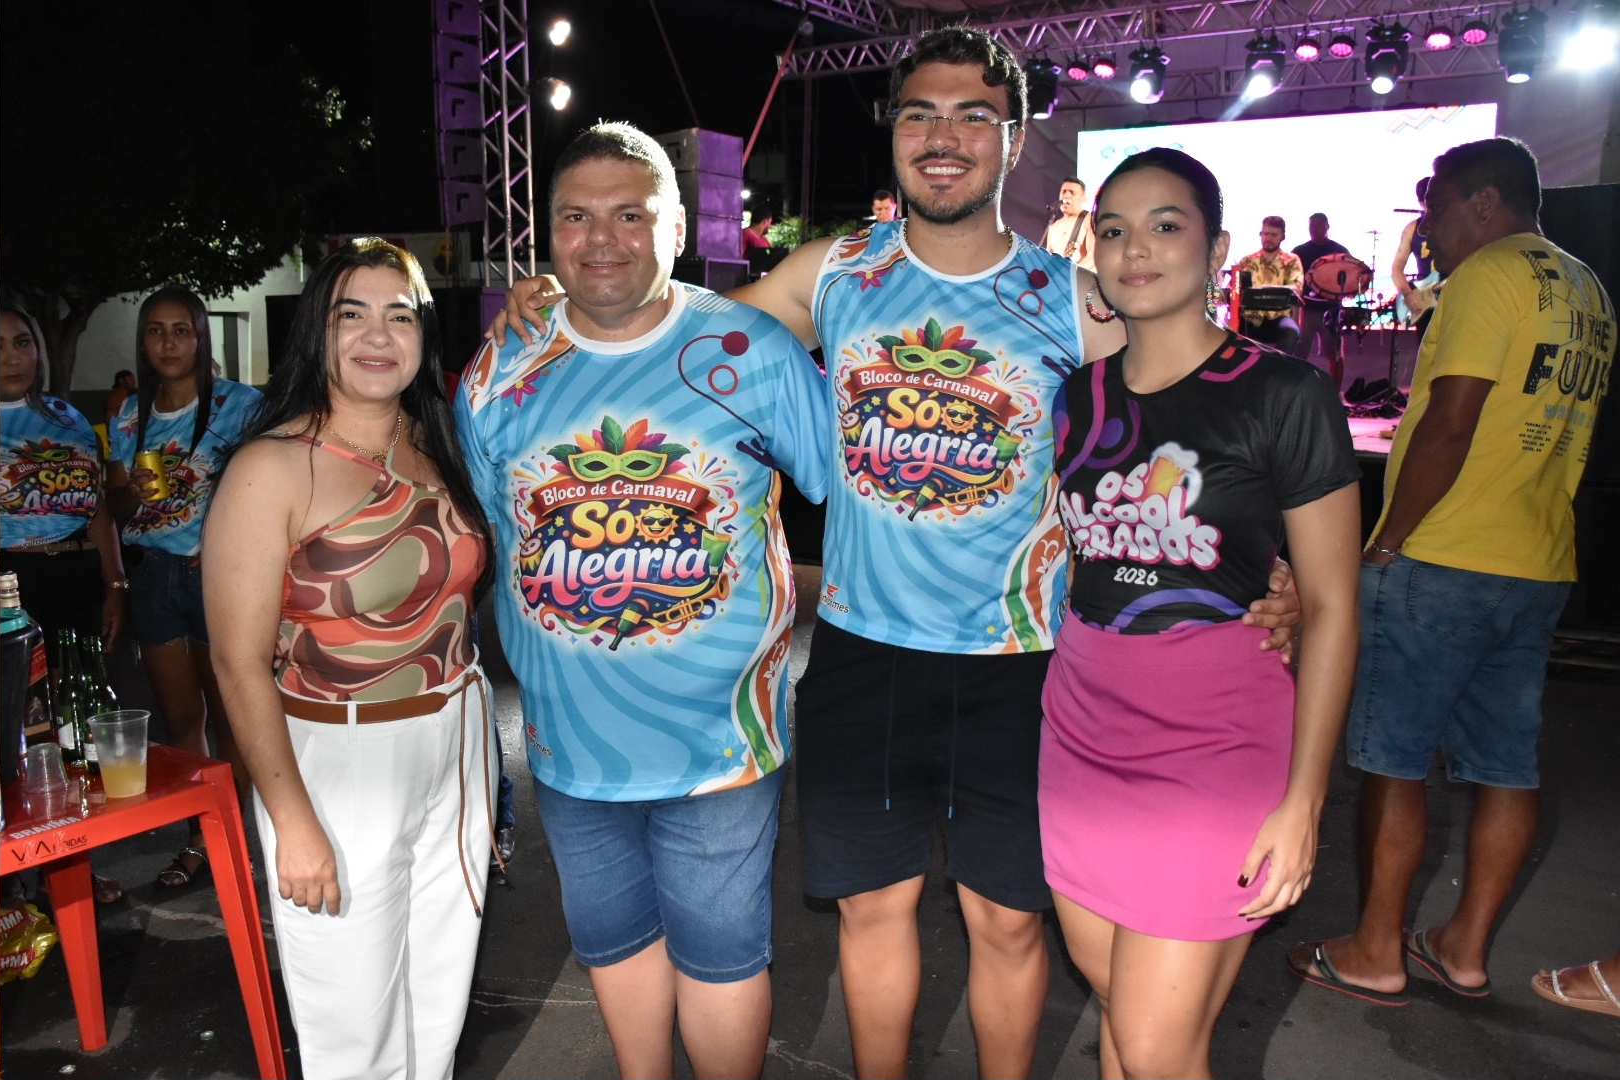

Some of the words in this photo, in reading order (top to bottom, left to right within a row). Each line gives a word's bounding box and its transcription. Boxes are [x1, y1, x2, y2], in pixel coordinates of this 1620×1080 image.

[859, 370, 902, 386] Bloco
[906, 373, 920, 384] de
[923, 374, 998, 404] Carnaval
[886, 388, 941, 430] Só
[846, 416, 998, 482] Alegria
[39, 467, 71, 494] Só
[540, 484, 586, 506] Bloco
[591, 482, 607, 496] de
[611, 480, 696, 504] Carnaval
[1096, 462, 1150, 501] OS
[570, 498, 636, 549] Só
[1059, 485, 1200, 536] ALCOOL
[521, 539, 709, 607] Alegria
[1114, 566, 1159, 586] 2026
[10, 815, 82, 840] BRAHMA
